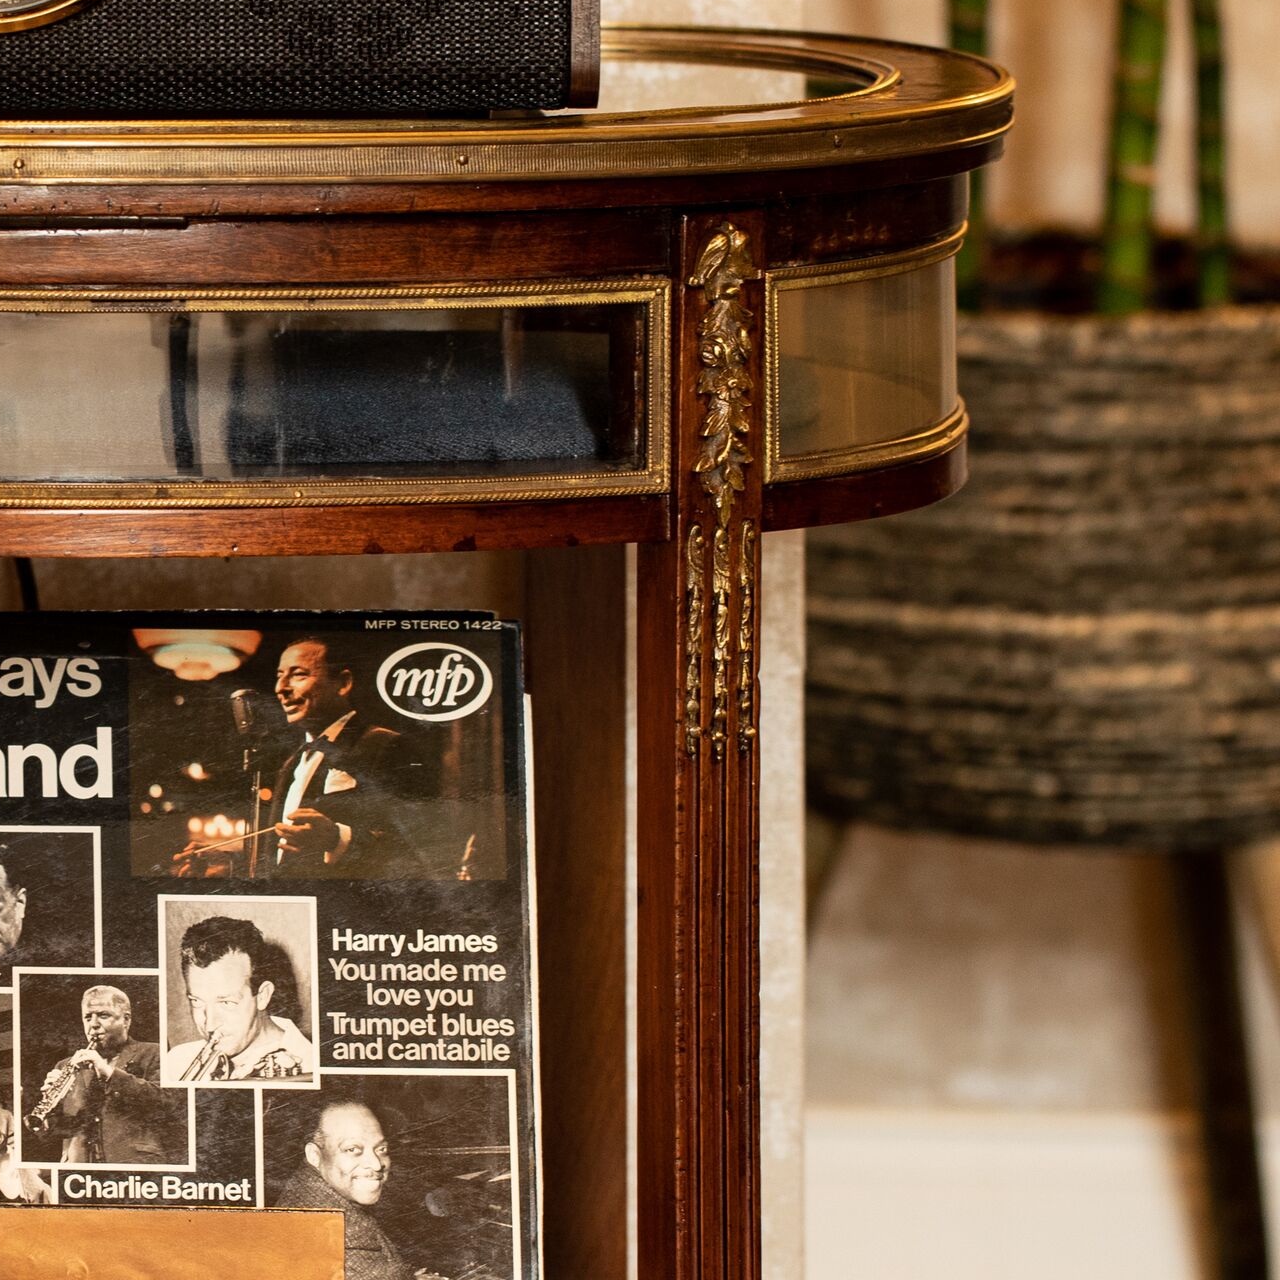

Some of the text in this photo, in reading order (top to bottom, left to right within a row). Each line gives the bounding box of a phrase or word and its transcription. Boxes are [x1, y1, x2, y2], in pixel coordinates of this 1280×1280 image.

[364, 619, 502, 631] MFP STEREO 1422
[392, 653, 475, 707] mfp
[332, 928, 498, 957] Harry James
[328, 958, 507, 982] You made me
[366, 983, 474, 1012] love you
[326, 1012, 515, 1041] Trumpet blues
[332, 1037, 511, 1062] and cantabile
[63, 1173, 252, 1202] Charlie Barnet
